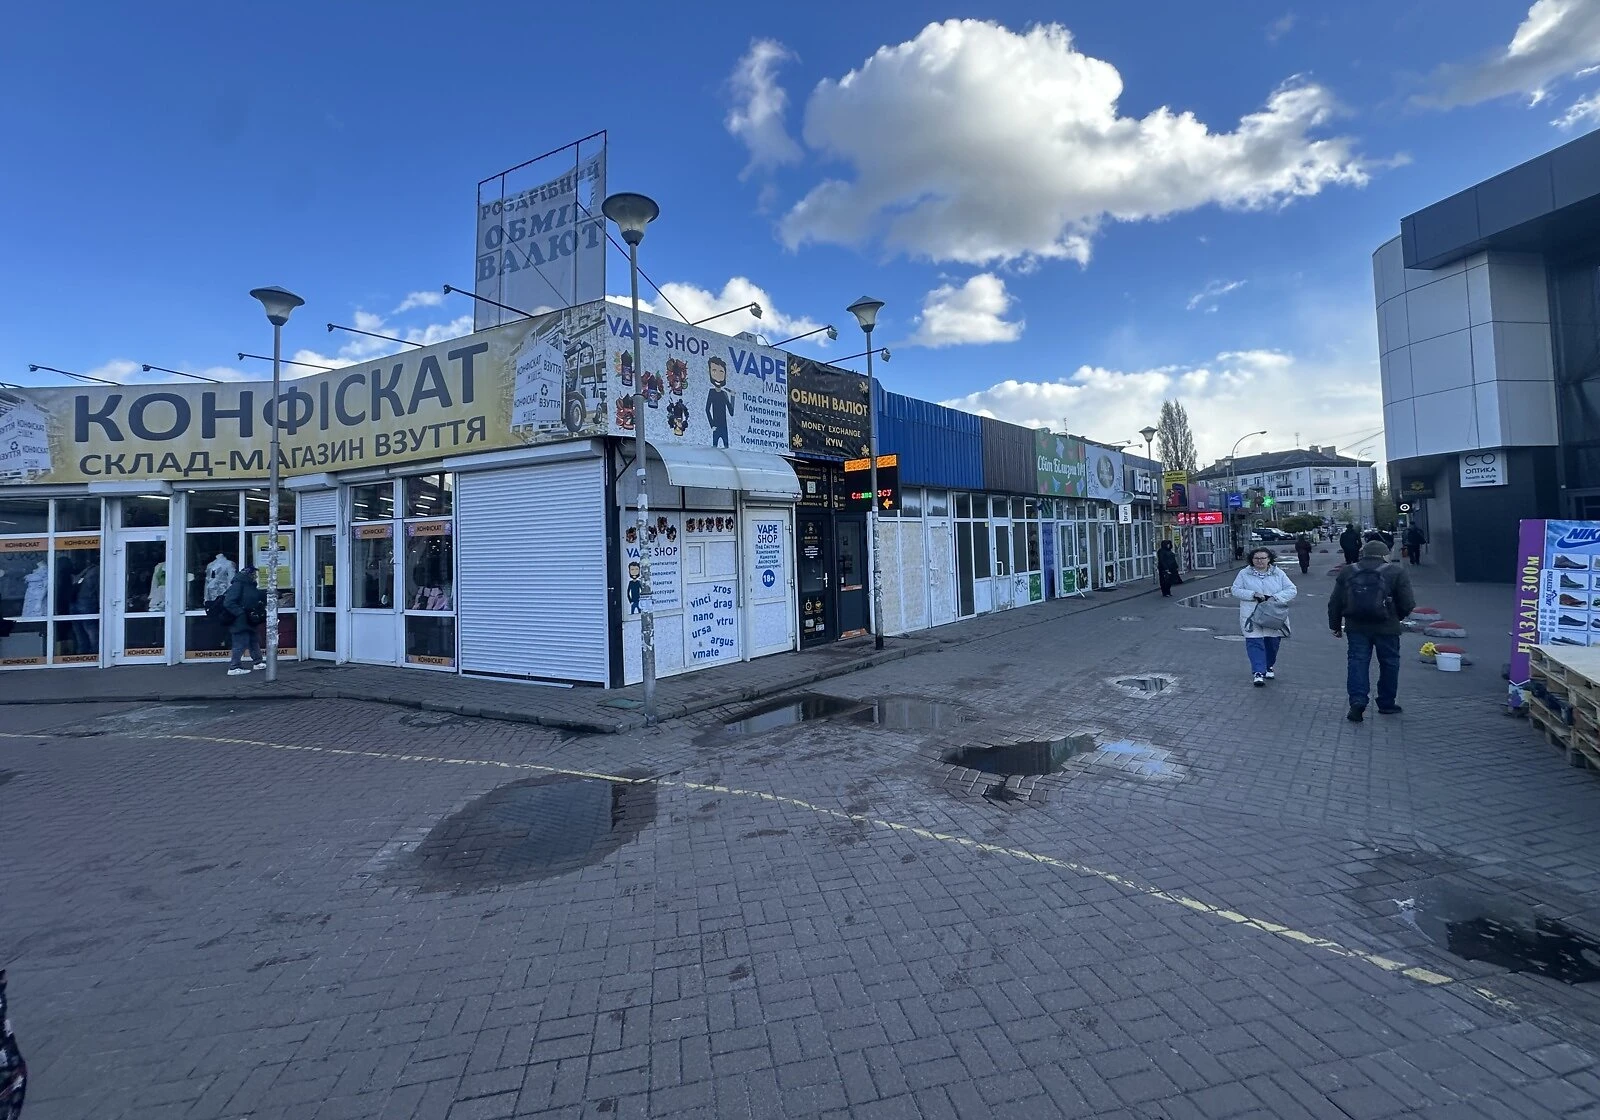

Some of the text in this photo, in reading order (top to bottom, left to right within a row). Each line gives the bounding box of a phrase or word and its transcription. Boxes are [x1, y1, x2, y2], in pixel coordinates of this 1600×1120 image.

[478, 218, 604, 282] ВАЛЮТ
[607, 314, 709, 357] VAPE SHOP
[544, 360, 561, 375] ВЗУТТЯ
[728, 346, 787, 385] VAPE
[74, 342, 489, 443] КОНФІСКАТ
[765, 381, 787, 396] MAN
[539, 398, 561, 409] ВЗУТТЯ
[742, 392, 787, 409] Под Системи
[791, 388, 868, 417] ОБМІН ВАЛЮТ
[743, 402, 787, 419] Компоненти
[750, 414, 781, 428] Намотки
[747, 425, 784, 439] Аксесуари
[801, 420, 861, 438] MONEY EXCHANGE
[79, 415, 487, 477] СКЛАД-МАГАЗИН ВЗУТТЯ
[825, 437, 844, 448] KYIV
[1465, 466, 1497, 475] ОПТИКА
[757, 524, 778, 534] VAPE
[1566, 528, 1600, 540] NIK
[757, 534, 778, 544] SHOP
[654, 546, 678, 557] SHOP
[763, 574, 775, 583] 18+
[713, 585, 732, 594] xros
[690, 593, 711, 608] vinci
[713, 599, 733, 609] drag
[693, 612, 714, 622] nano
[716, 617, 734, 626] vtru
[692, 625, 712, 639] ursa
[1518, 598, 1539, 653] НАЗАД
[710, 636, 734, 647] argus
[127, 648, 163, 656] КОНФІСКАТ
[692, 648, 720, 659] vmate
